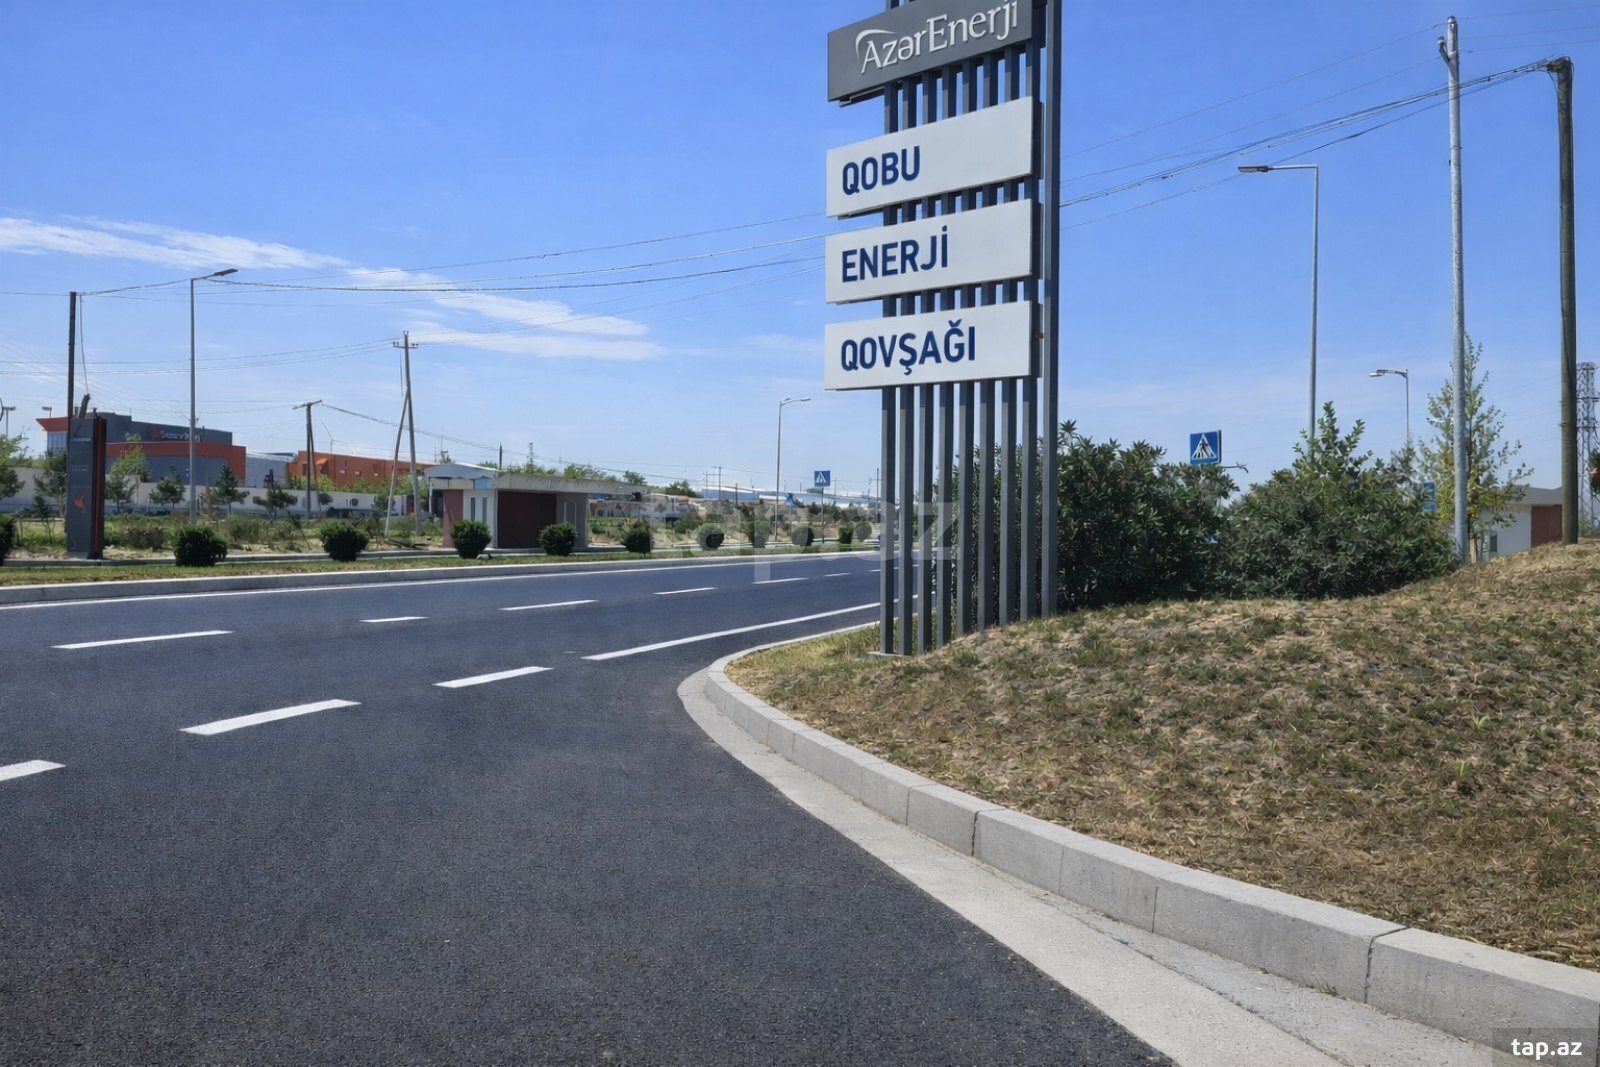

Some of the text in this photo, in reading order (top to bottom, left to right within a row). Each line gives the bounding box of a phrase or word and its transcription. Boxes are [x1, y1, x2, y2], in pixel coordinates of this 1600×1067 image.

[860, 0, 1018, 74] AzərEnerji
[842, 145, 921, 196] QOBU
[842, 225, 948, 283] ENERJİ
[840, 318, 976, 376] QOVŞAĞI
